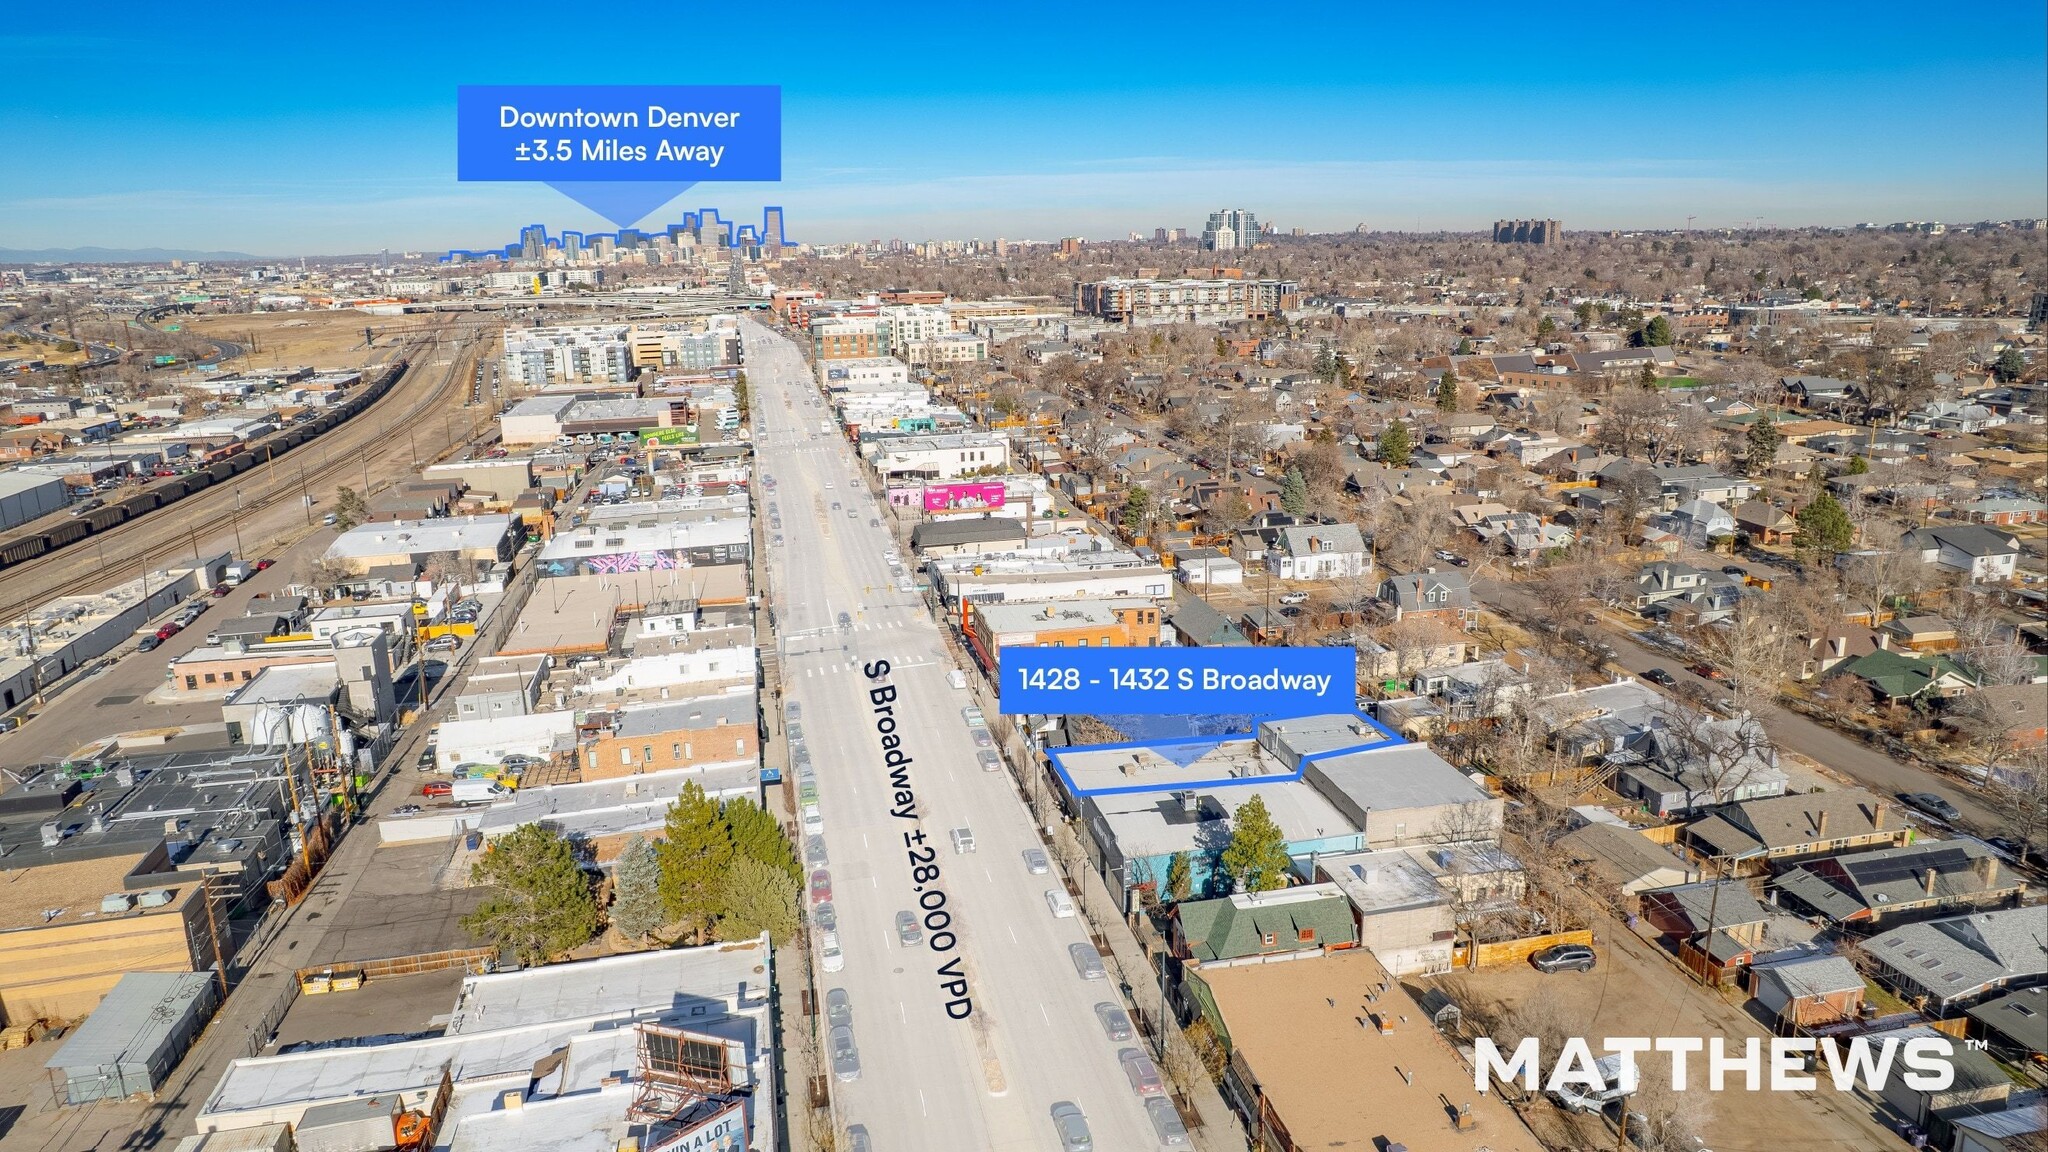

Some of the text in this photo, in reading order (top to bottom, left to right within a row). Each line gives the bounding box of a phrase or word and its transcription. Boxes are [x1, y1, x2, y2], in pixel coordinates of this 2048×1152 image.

[667, 1119, 732, 1152] IN A LOT
